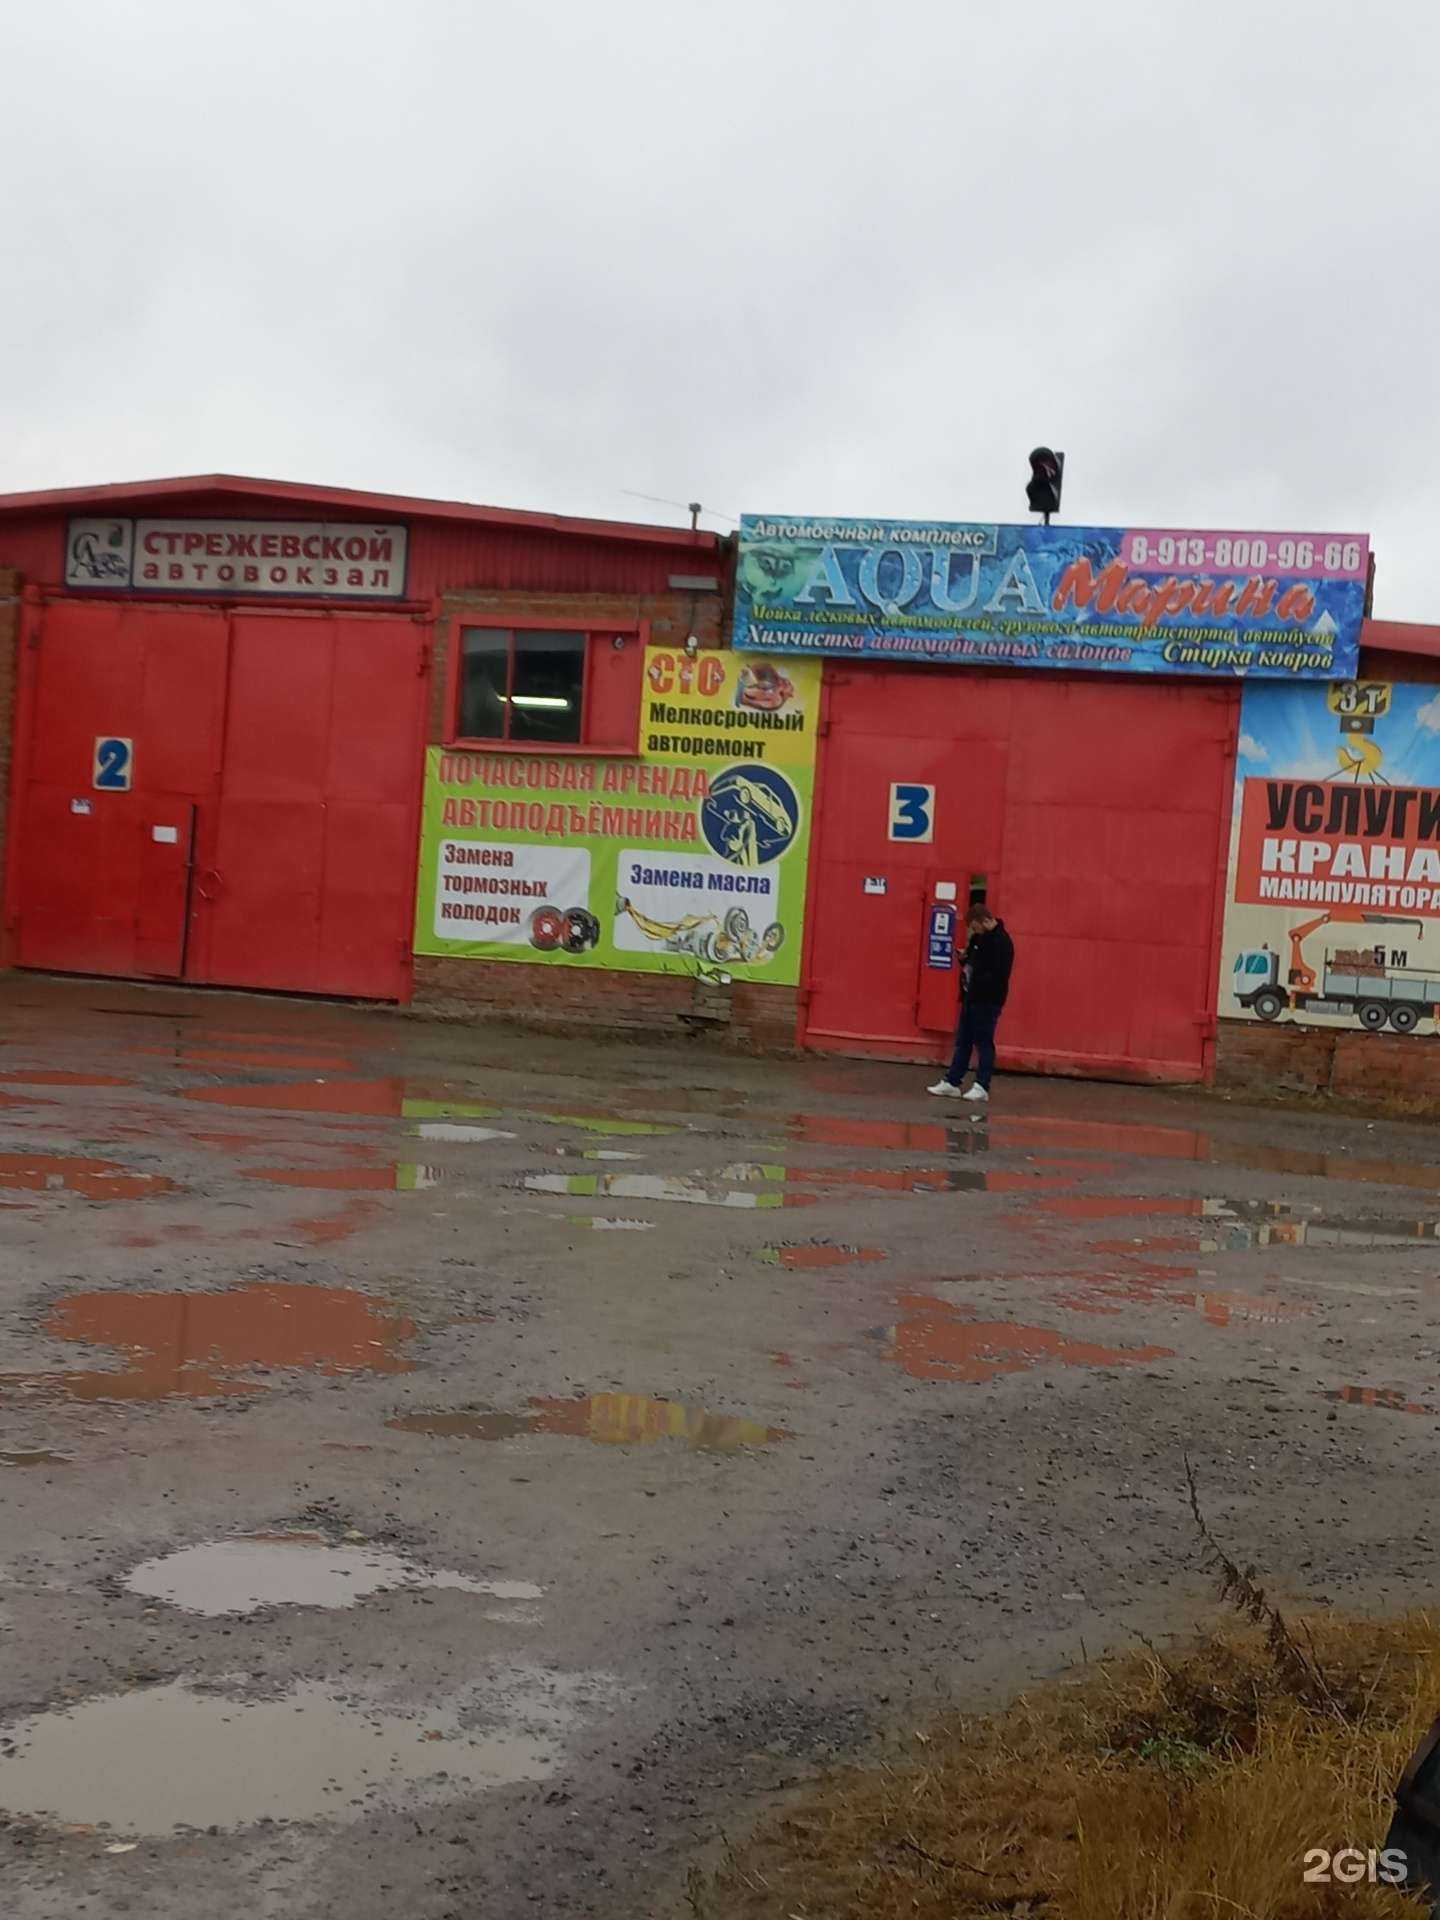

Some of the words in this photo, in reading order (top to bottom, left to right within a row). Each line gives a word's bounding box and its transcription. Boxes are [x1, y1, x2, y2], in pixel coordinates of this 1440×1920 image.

[143, 528, 393, 563] СТРЕЖЕВСКОЙ
[754, 520, 884, 543] Автомоечный
[889, 527, 985, 545] комплекс
[1131, 535, 1360, 571] 8-913-800-96-66
[143, 559, 390, 588] автовокзал
[793, 543, 1047, 617] AQUA
[1052, 555, 1316, 628] Марина
[752, 604, 801, 622] Мойка
[747, 624, 865, 649] Химчистка
[870, 634, 1039, 657] автомобильных
[1046, 644, 1133, 661] салонов
[1163, 641, 1253, 669] Стирка
[1258, 650, 1333, 673] ковров
[649, 653, 725, 696] СТО
[1339, 683, 1357, 712] 3
[650, 702, 804, 733] Мелкосрочный
[96, 740, 130, 787] 2
[648, 734, 766, 759] авторемонт
[438, 755, 597, 791] ПОЧАСОВАЯ
[602, 763, 711, 800] АРЕНДА
[442, 796, 699, 843] АВТОПОДЪЁМНИКА
[892, 785, 930, 838] 3
[1265, 782, 1440, 843] УСЛУГИ
[445, 844, 514, 868] Замена
[1261, 838, 1440, 884] КРАНА
[443, 873, 548, 899] тормозных
[630, 863, 703, 890] Замена
[707, 872, 771, 895] масла
[1259, 876, 1440, 911] МАНИПУЛЯТОРА
[441, 903, 521, 925] колодок
[1374, 945, 1386, 966] 5
